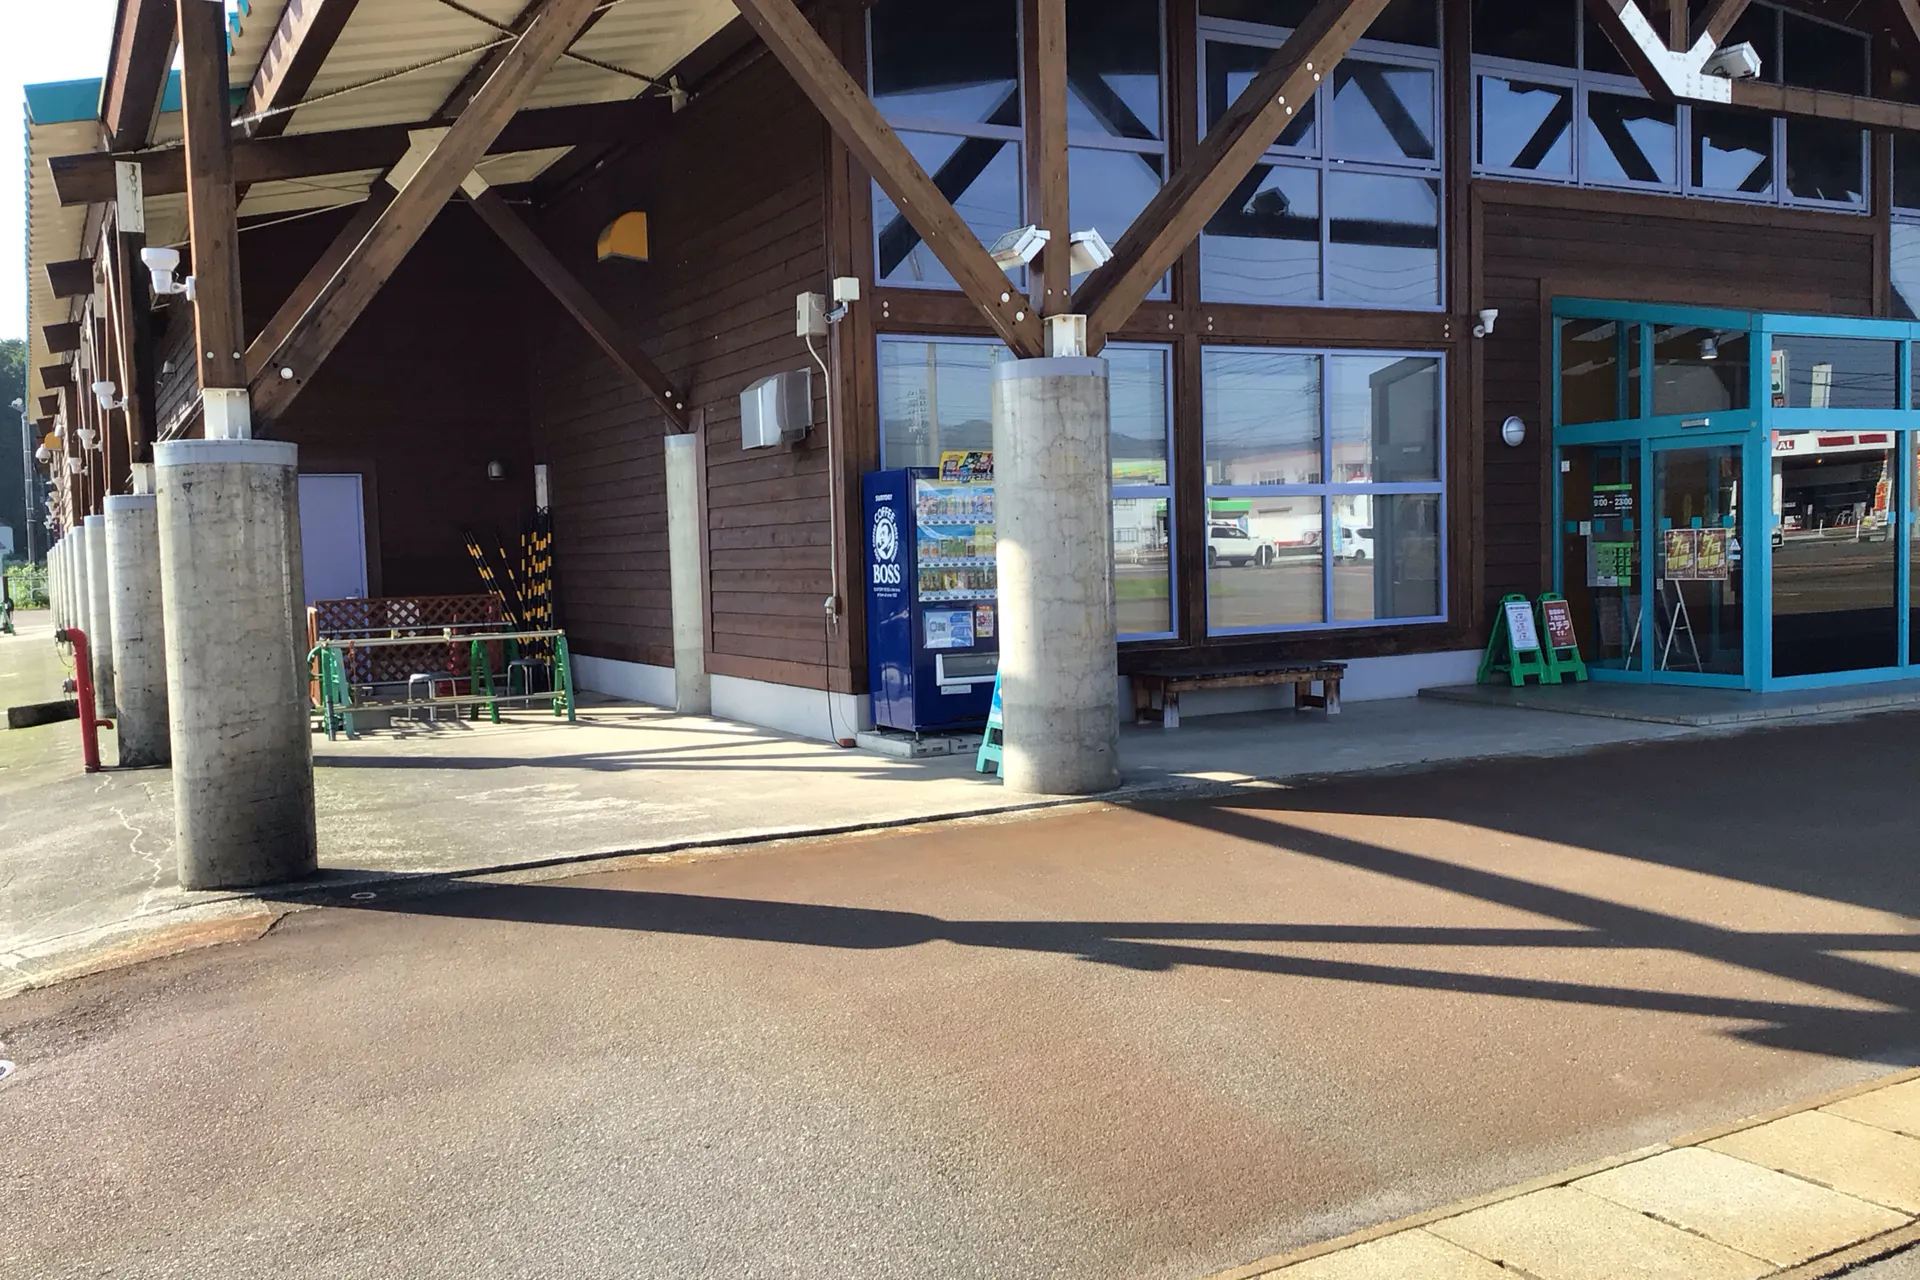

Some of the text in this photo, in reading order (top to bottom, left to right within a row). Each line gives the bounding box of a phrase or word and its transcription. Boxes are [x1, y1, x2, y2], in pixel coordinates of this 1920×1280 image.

[1593, 498, 1608, 507] 9:00
[1614, 497, 1633, 506] 23:00
[874, 506, 896, 524] COFFEE
[1702, 534, 1721, 557] 7月
[873, 564, 900, 584] BOSS
[1549, 620, 1570, 631] コチラ
